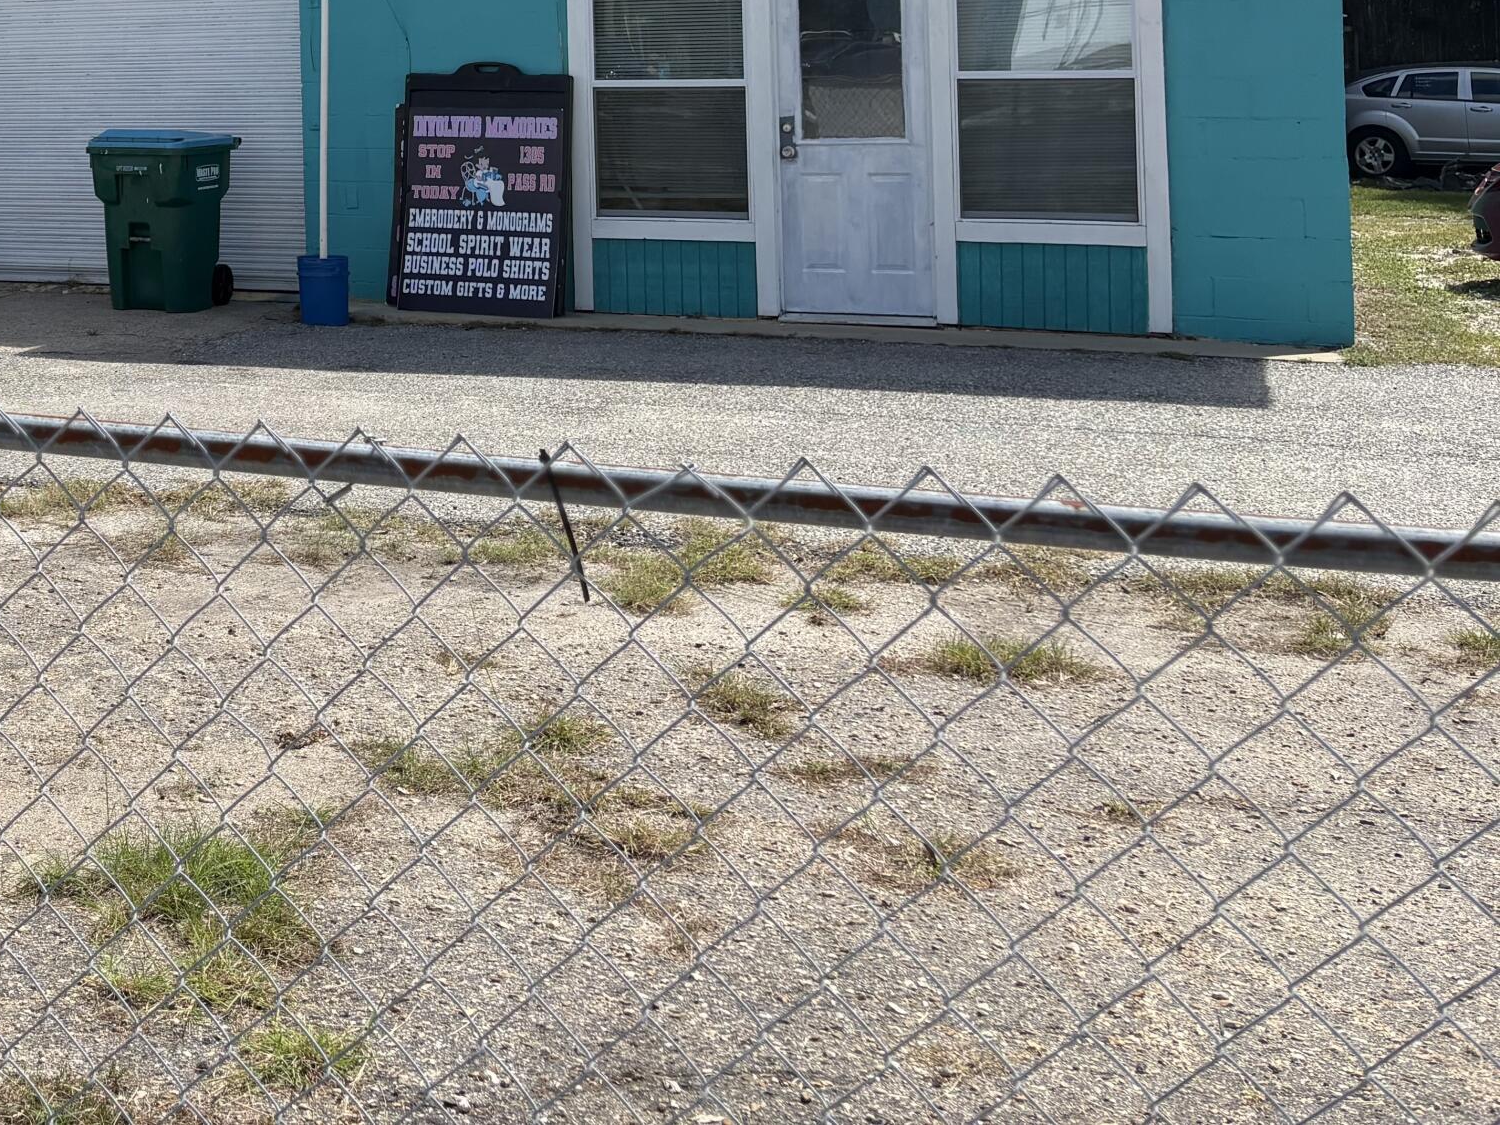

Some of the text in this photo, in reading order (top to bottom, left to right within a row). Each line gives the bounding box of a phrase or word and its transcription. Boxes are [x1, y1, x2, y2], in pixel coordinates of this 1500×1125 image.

[485, 116, 558, 139] MEMORIES
[418, 144, 456, 158] STOP
[519, 145, 545, 164] 1305
[425, 165, 442, 179] IN
[411, 185, 460, 200] TODAY
[507, 173, 556, 193] PASS RD
[408, 208, 474, 230] EMBROIDERY
[486, 211, 553, 233] MONOGRAMS
[406, 232, 550, 258] SCHOOL SPIRIT WEAR
[403, 254, 550, 281] BUSINESS POLO SHIRTS
[402, 278, 453, 296] CUSTOM
[456, 282, 493, 299] GIFTS
[508, 284, 547, 301] MORE
